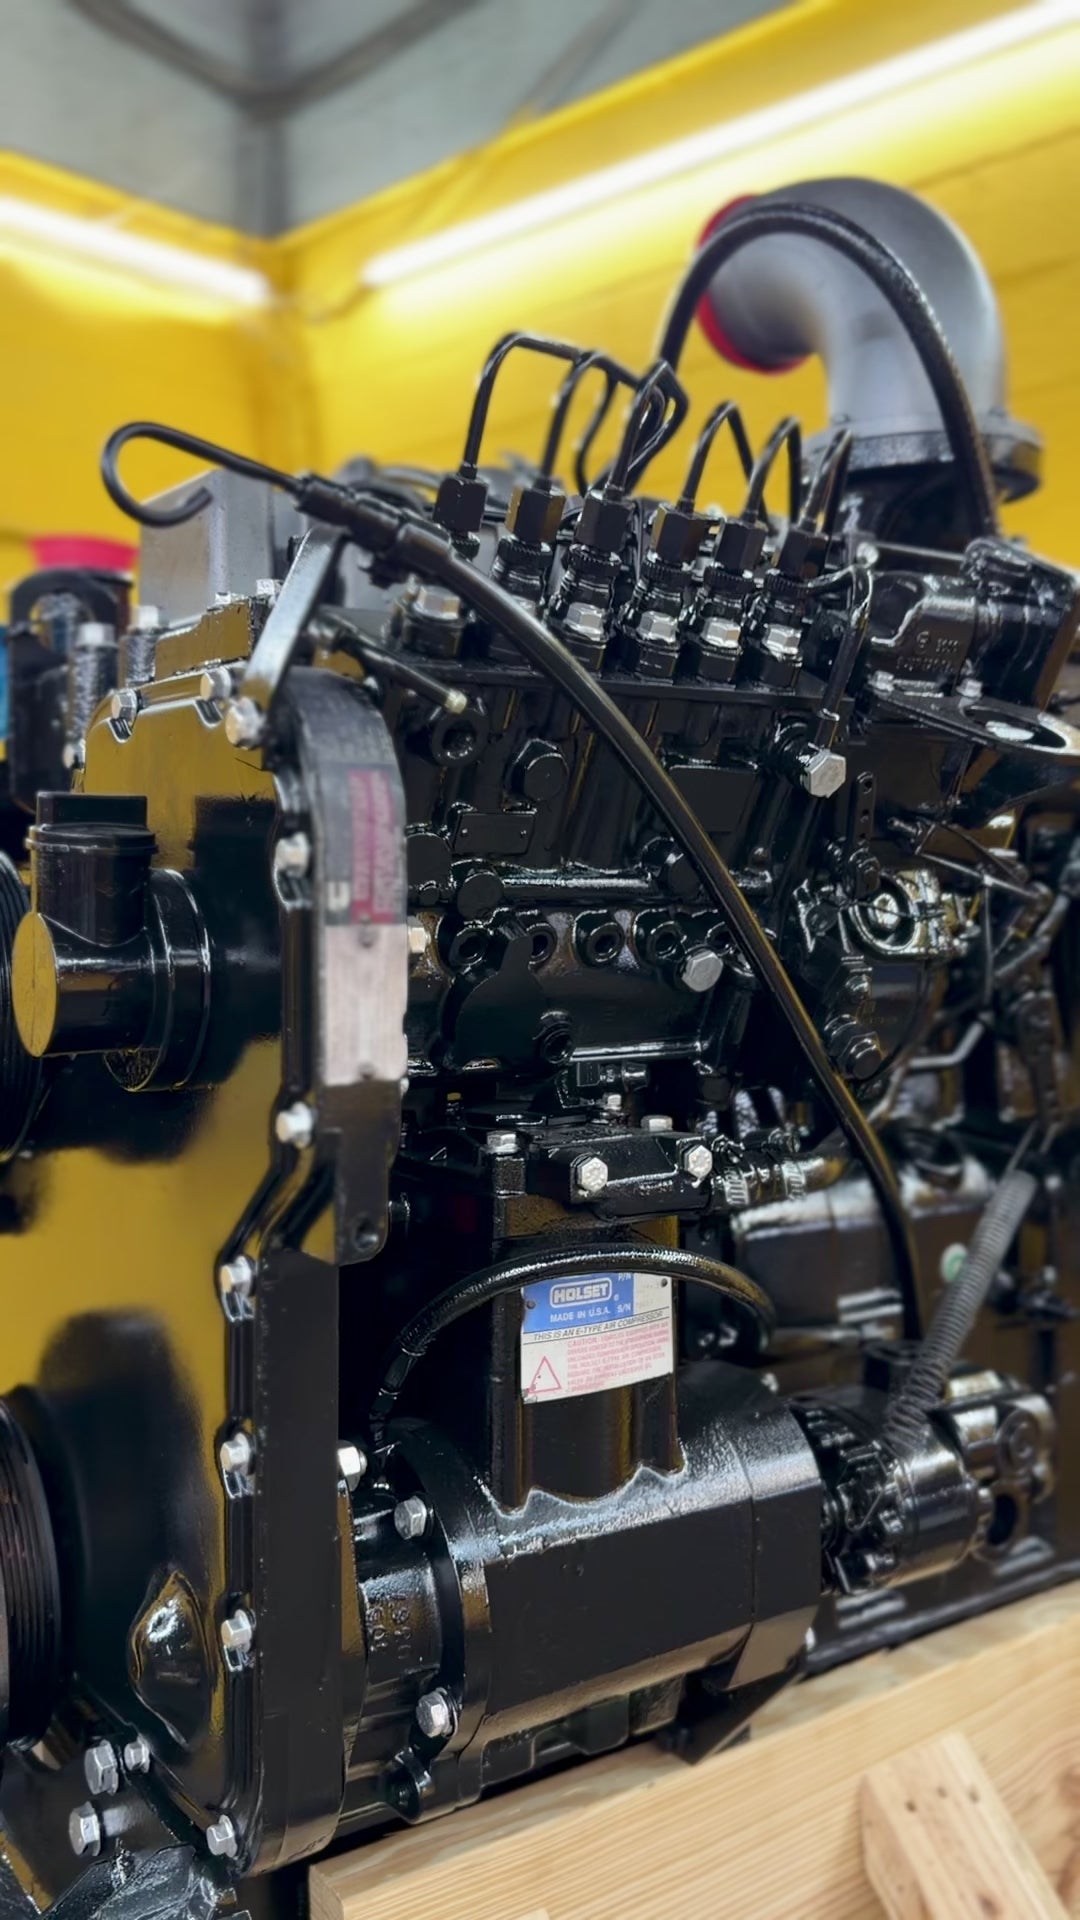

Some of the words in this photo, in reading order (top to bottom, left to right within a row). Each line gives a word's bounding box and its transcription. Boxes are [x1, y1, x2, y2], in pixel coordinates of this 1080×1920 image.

[553, 1282, 609, 1303] HOLSET
[617, 1302, 632, 1313] S/N
[550, 1311, 575, 1323] MADE
[577, 1310, 587, 1319] IN
[533, 1332, 552, 1341] THIS
[553, 1330, 562, 1339] IS
[562, 1328, 576, 1338] AN
[576, 1324, 602, 1336] E-TYPE
[604, 1321, 617, 1331] AIR
[618, 1311, 664, 1327] COMPRESSOR
